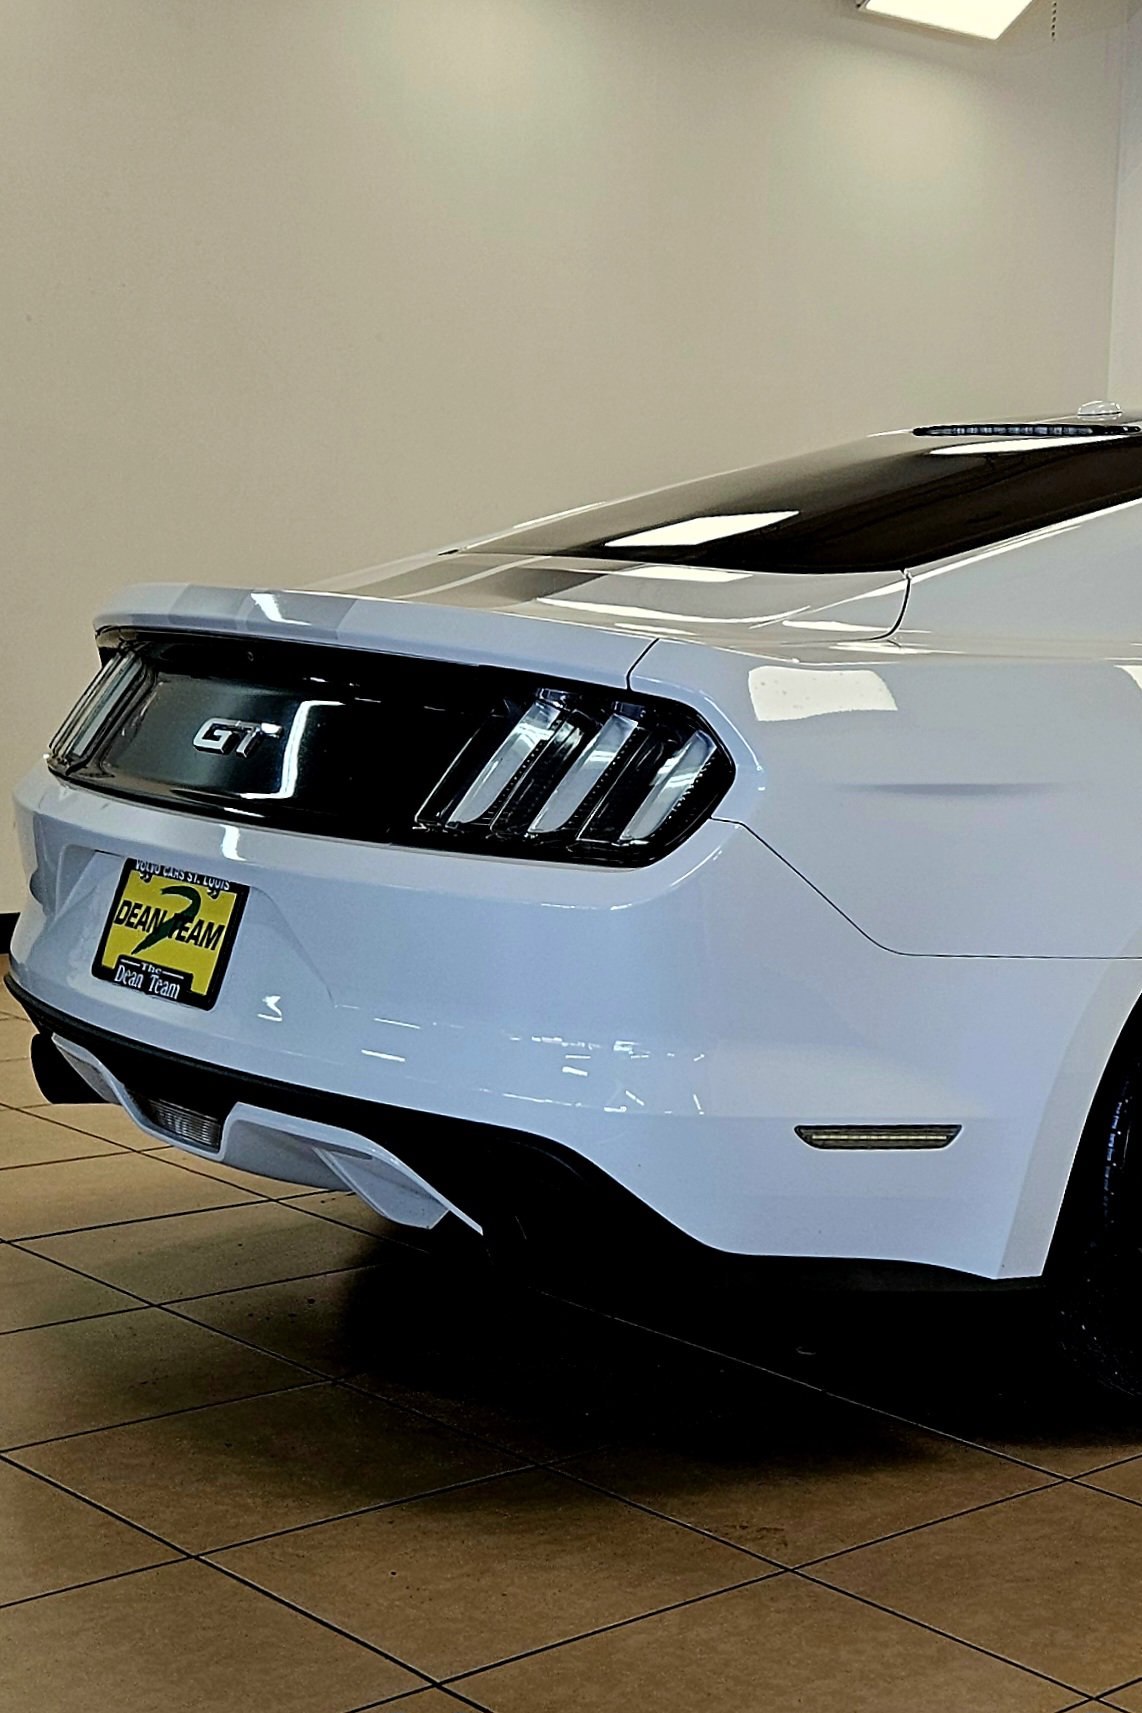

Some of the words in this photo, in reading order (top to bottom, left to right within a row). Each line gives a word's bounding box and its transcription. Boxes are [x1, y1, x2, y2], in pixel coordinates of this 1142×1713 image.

[193, 717, 283, 757] GT
[135, 860, 161, 875] VOLVO
[163, 866, 185, 880] CARS
[187, 873, 201, 884] ST.
[203, 876, 230, 891] LOUIS
[114, 900, 167, 933] DEAN
[167, 914, 225, 951] TEAM
[114, 964, 144, 989] Dean
[148, 974, 180, 1000] Team
[141, 962, 162, 975] The
